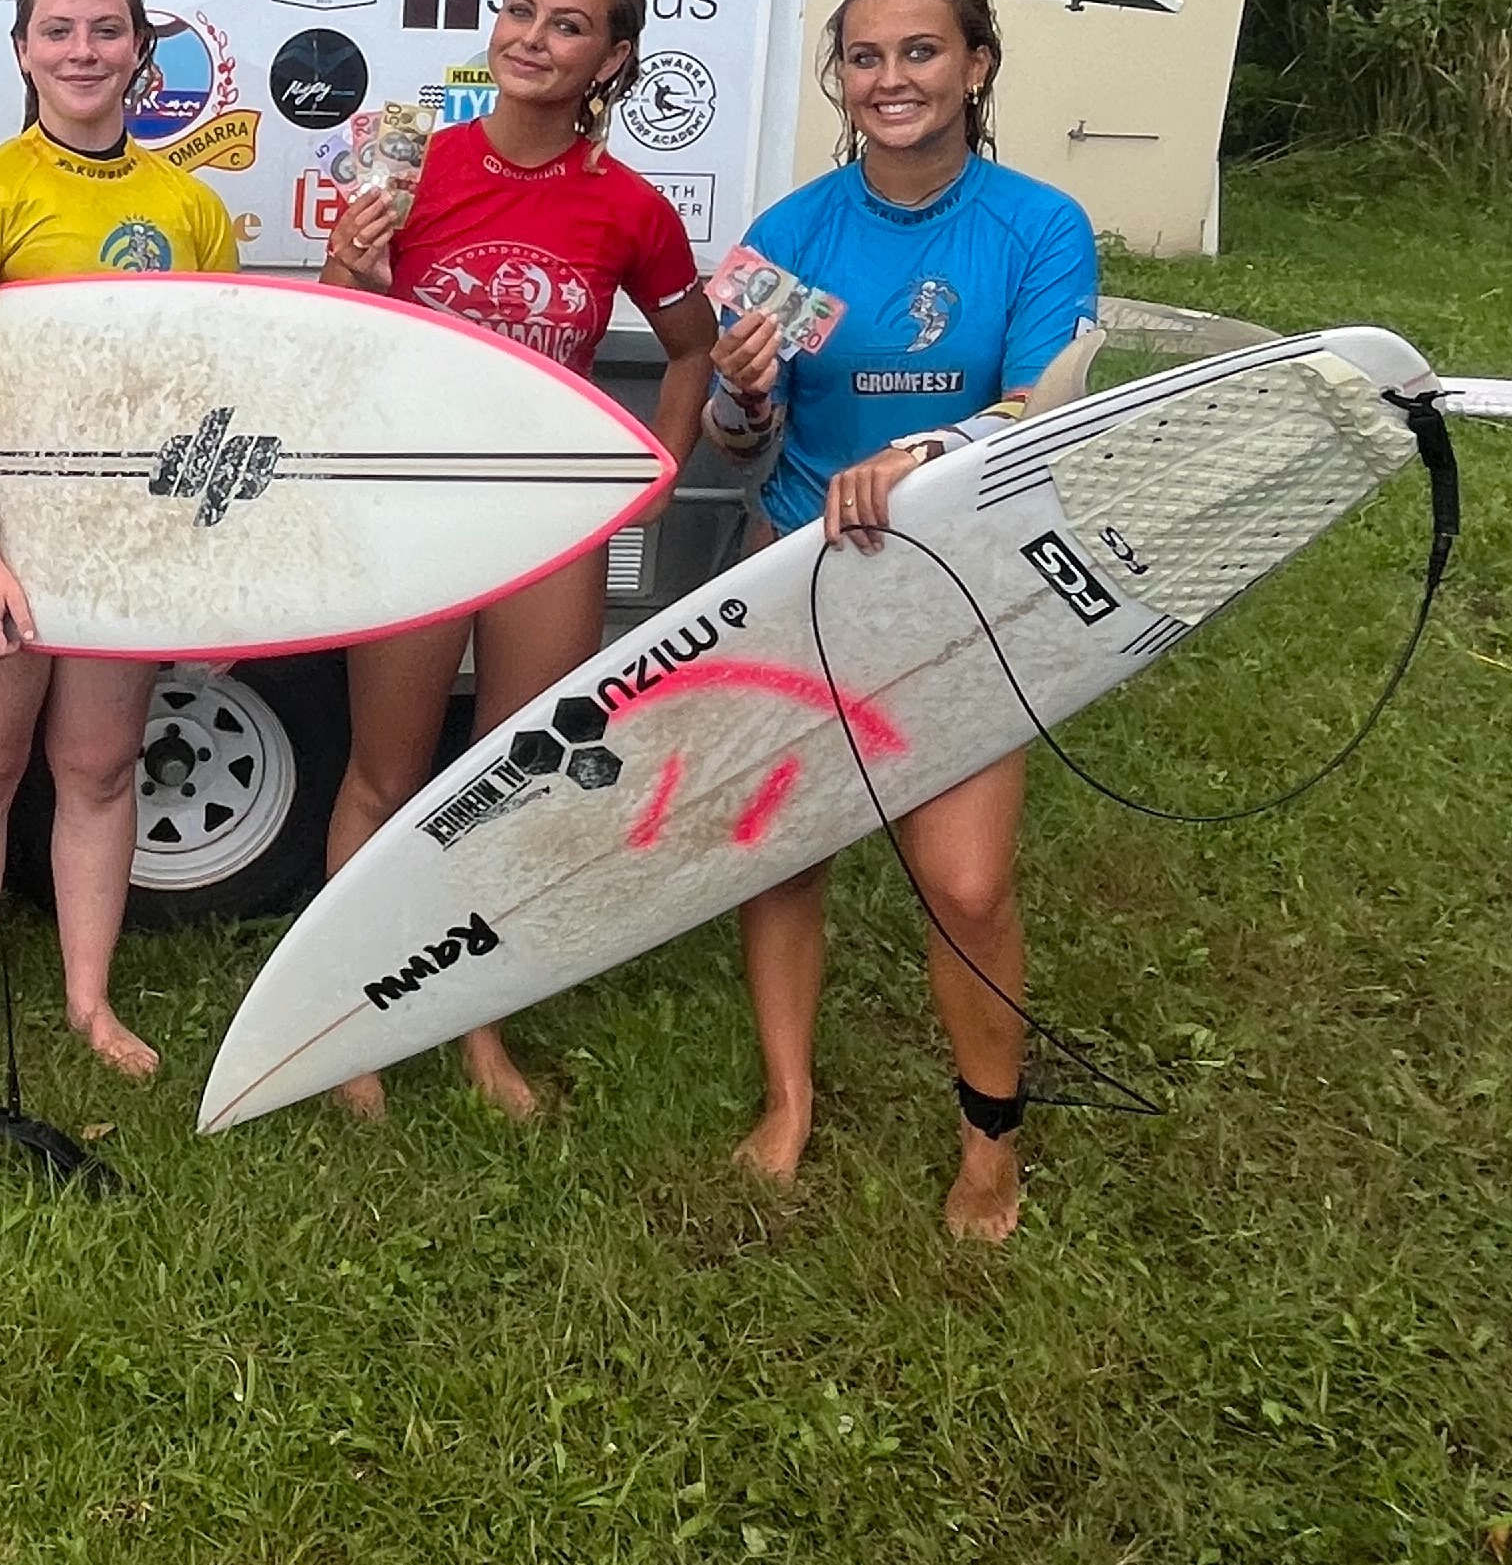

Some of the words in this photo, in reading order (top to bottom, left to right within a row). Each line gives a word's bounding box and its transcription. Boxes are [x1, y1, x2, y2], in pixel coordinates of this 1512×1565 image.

[639, 57, 706, 88] LAWARRA
[627, 108, 651, 139] SURF
[652, 111, 706, 145] ACADEMY
[168, 122, 249, 167] OMBARRA
[855, 371, 963, 393] GROMFEST
[1032, 542, 1110, 616] FCS
[491, 760, 526, 789] AL
